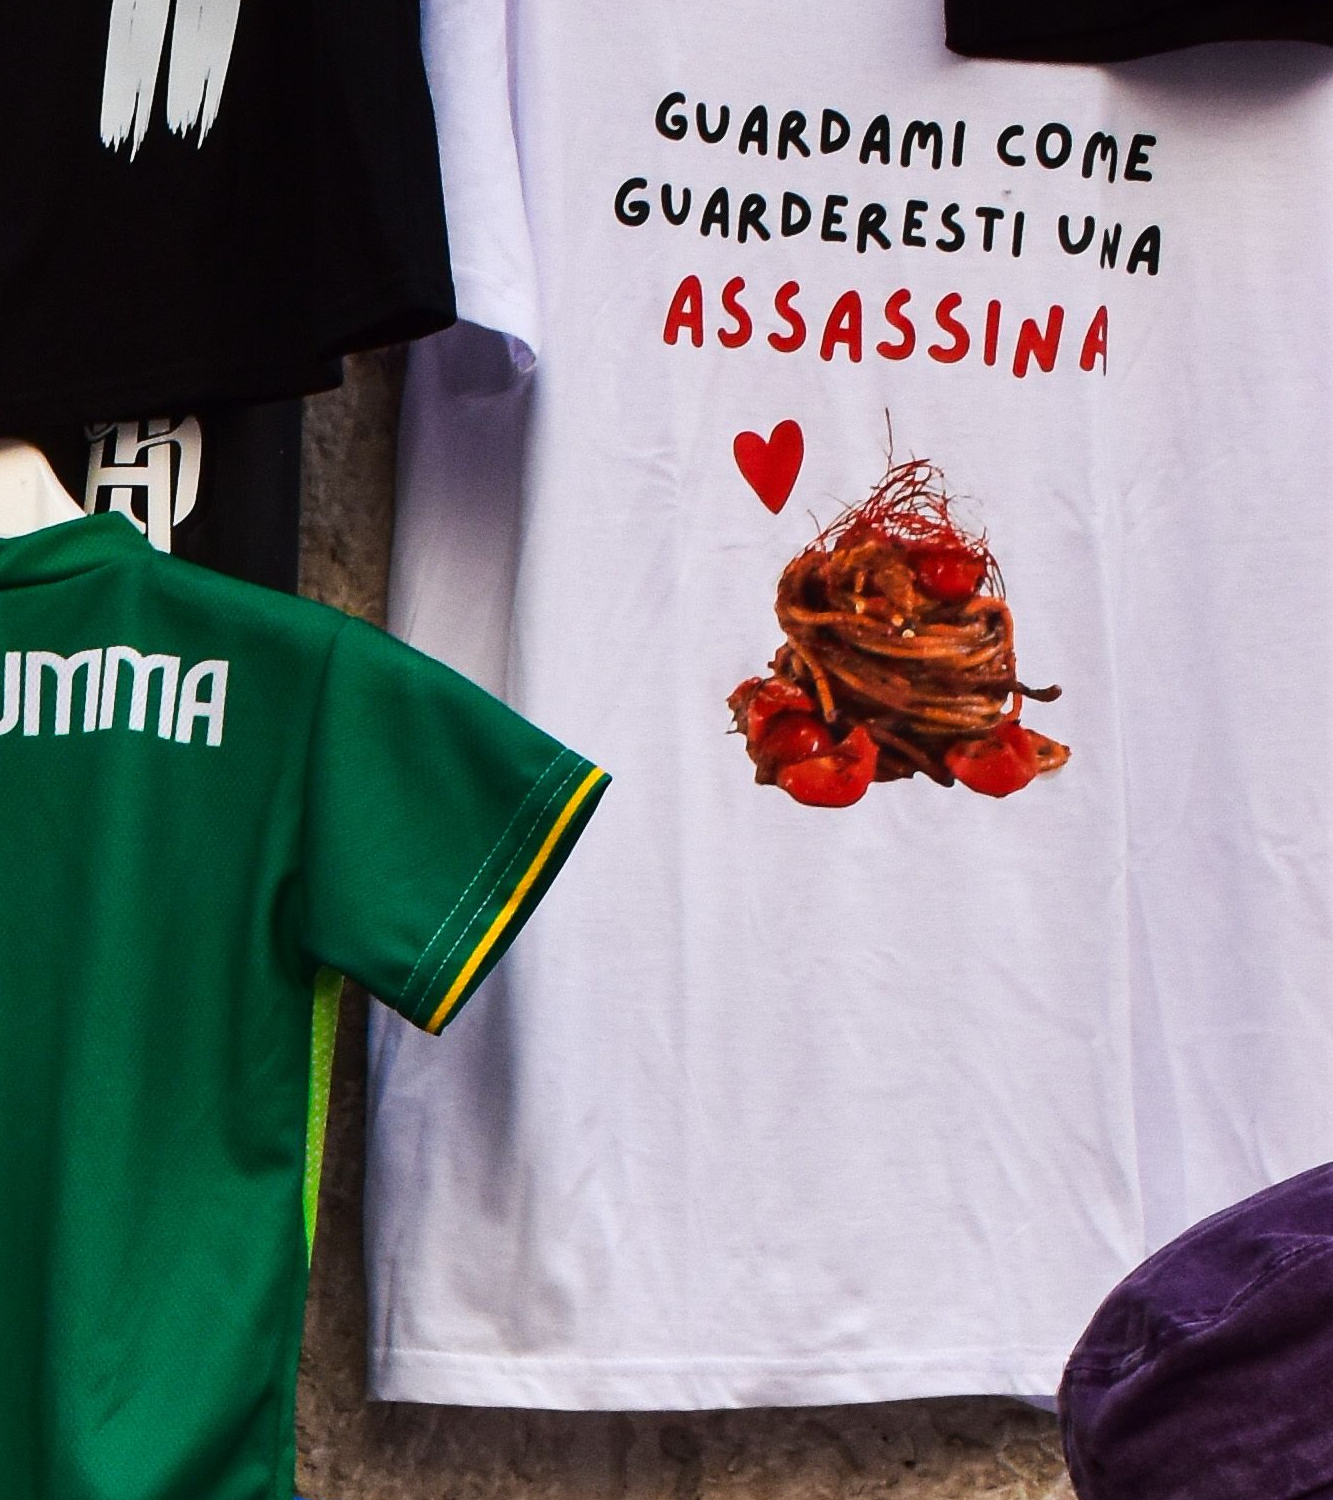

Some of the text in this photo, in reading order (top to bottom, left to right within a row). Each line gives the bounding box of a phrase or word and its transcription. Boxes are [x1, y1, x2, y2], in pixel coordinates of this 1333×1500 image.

[655, 90, 1158, 184] GUARDAMI COME
[614, 176, 1161, 277] GUARDERESTI UNA
[663, 274, 1109, 380] ASSASSINA
